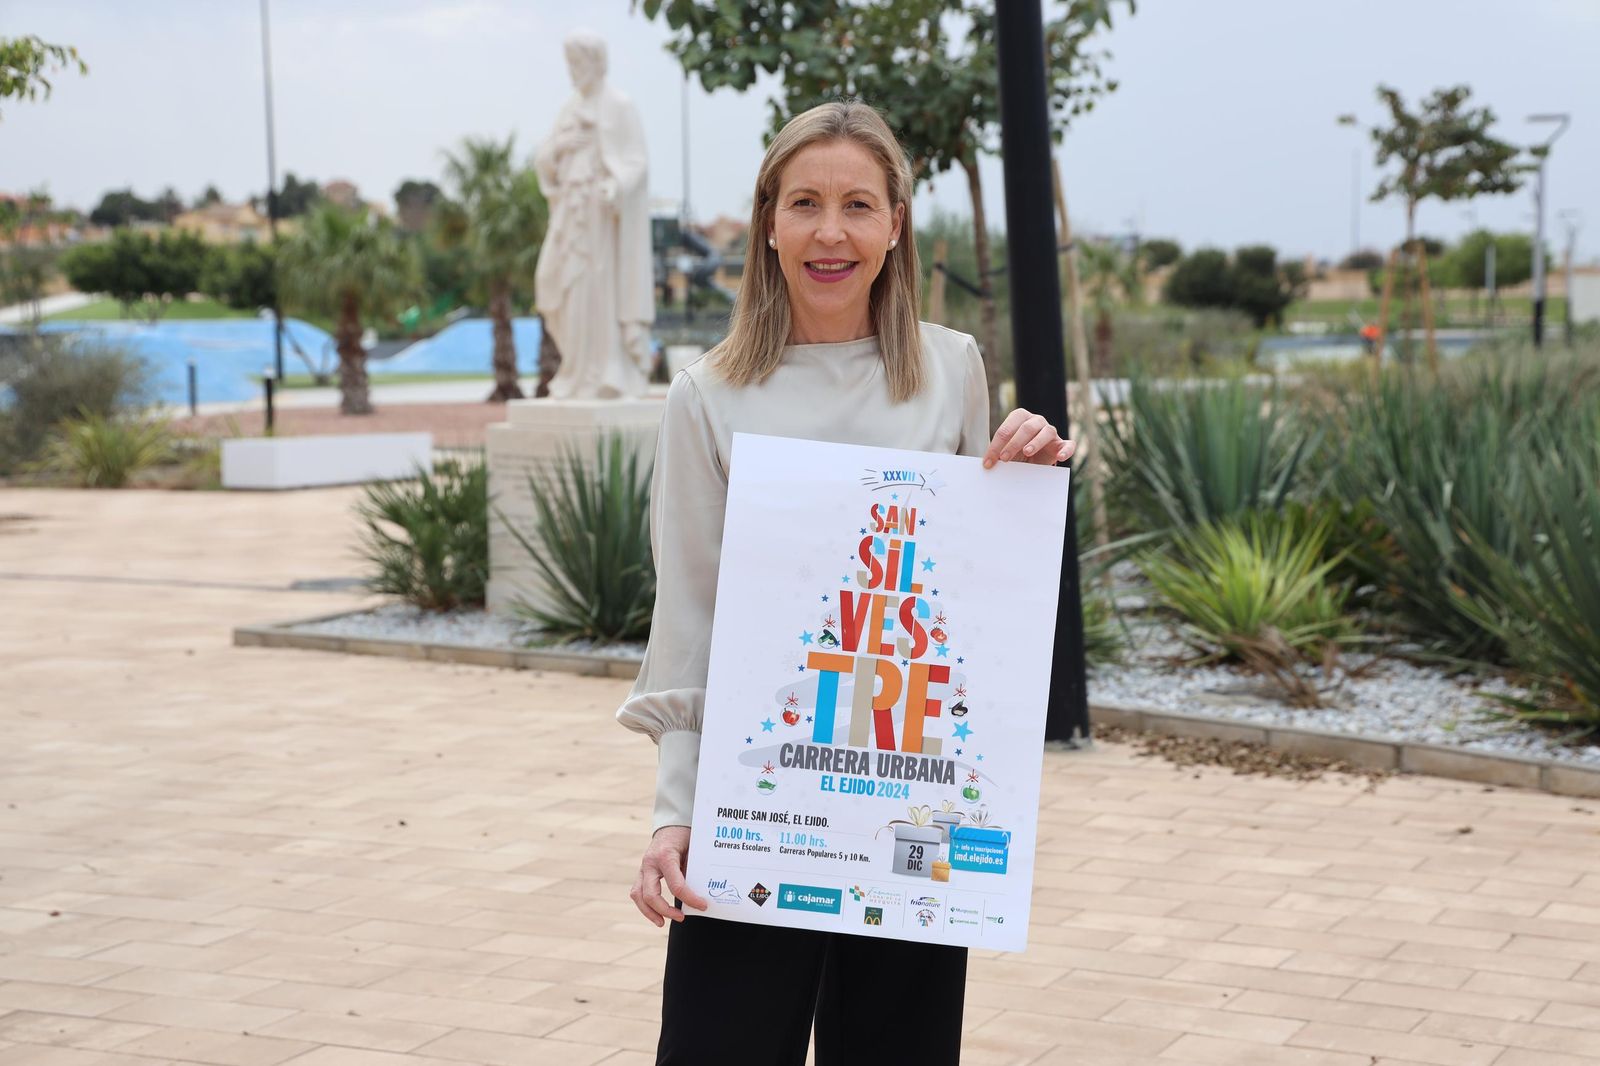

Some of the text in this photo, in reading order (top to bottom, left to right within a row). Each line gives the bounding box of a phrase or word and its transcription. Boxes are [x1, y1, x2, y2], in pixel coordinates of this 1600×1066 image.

[882, 470, 916, 482] XXXVII
[869, 503, 917, 536] SAN
[839, 590, 930, 659] VES
[806, 651, 951, 755] TRE
[779, 742, 956, 785] CARRERA URBANA
[820, 775, 910, 800] EL EJIDO 2024
[717, 807, 830, 828] PARQUE SAN JOSÉ, EL EJIDO.
[715, 826, 764, 842] 10.00 hrs.
[779, 831, 828, 847] 11.00 hrs.
[713, 840, 771, 853] Carreras Escolares
[779, 845, 871, 863] Carreras Populares 5 y 10 Km.
[908, 844, 924, 860] 29
[907, 859, 923, 871] DIC
[954, 850, 1004, 866] imd.elejido.es
[707, 878, 728, 890] imd
[797, 893, 836, 905] cajamar
[910, 898, 941, 908] frionature
